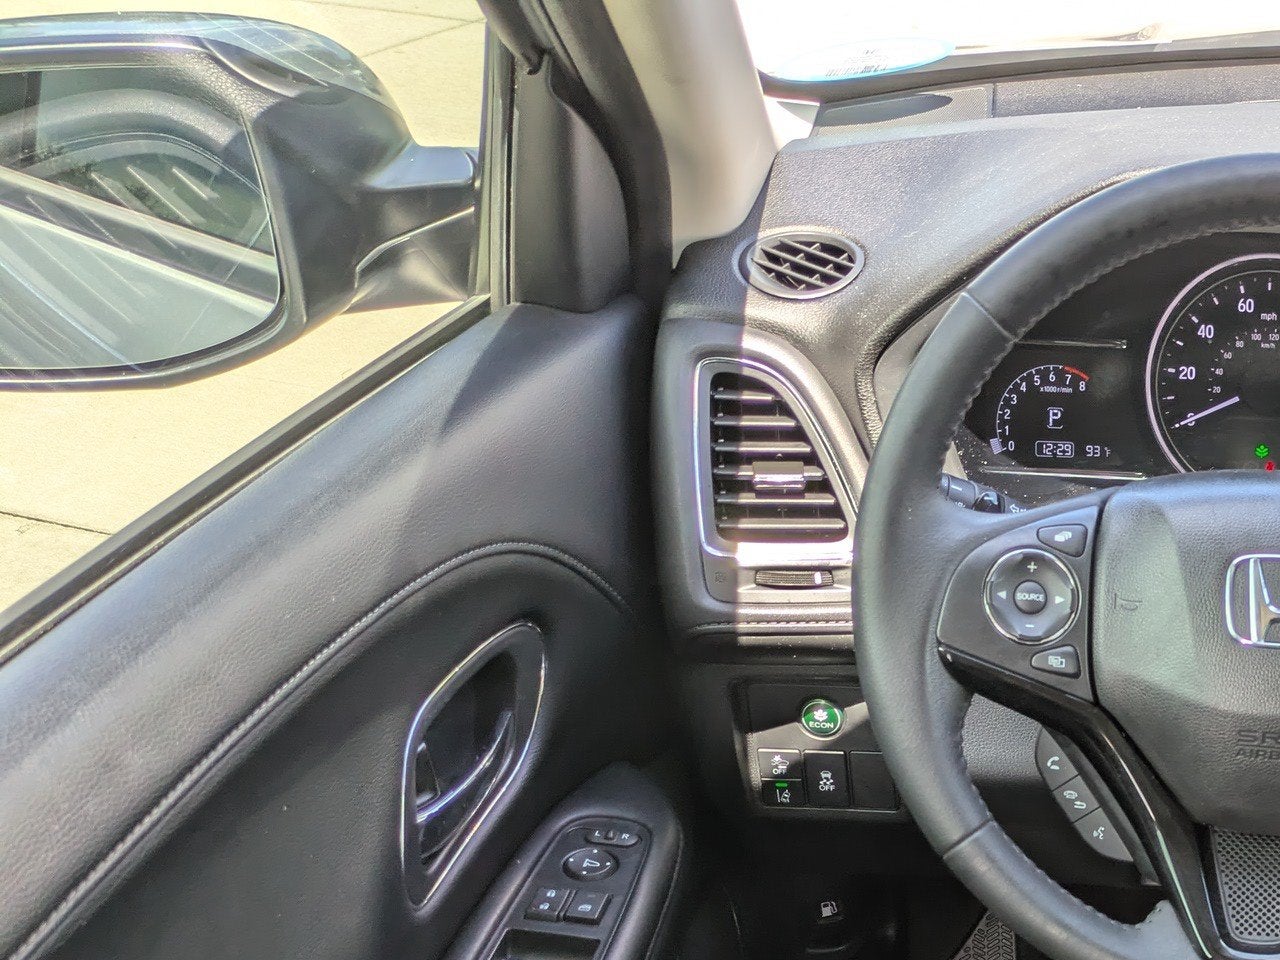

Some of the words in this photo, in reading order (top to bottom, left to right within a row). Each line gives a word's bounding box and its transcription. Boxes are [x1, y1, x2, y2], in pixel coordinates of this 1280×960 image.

[1237, 298, 1254, 313] 60
[1260, 313, 1277, 321] mph
[1197, 325, 1214, 339] 40
[1251, 333, 1261, 341] 100
[1269, 333, 1279, 341] 120
[1049, 371, 1056, 382] 6
[1179, 366, 1196, 380] 20
[1034, 375, 1041, 385] 5
[1065, 374, 1072, 385] 7
[1020, 382, 1027, 392] 4
[1079, 381, 1086, 391] 8
[1010, 394, 1017, 404] 3
[1004, 409, 1011, 419] 2
[1049, 409, 1061, 427] P
[1004, 425, 1009, 435] 1
[1008, 441, 1015, 451] 0
[1042, 443, 1072, 455] 12:29
[1085, 445, 1100, 457] 93
[1016, 592, 1045, 602] SOURCE
[809, 721, 834, 729] ECON
[772, 767, 788, 775] OFF
[819, 784, 835, 792] OFF
